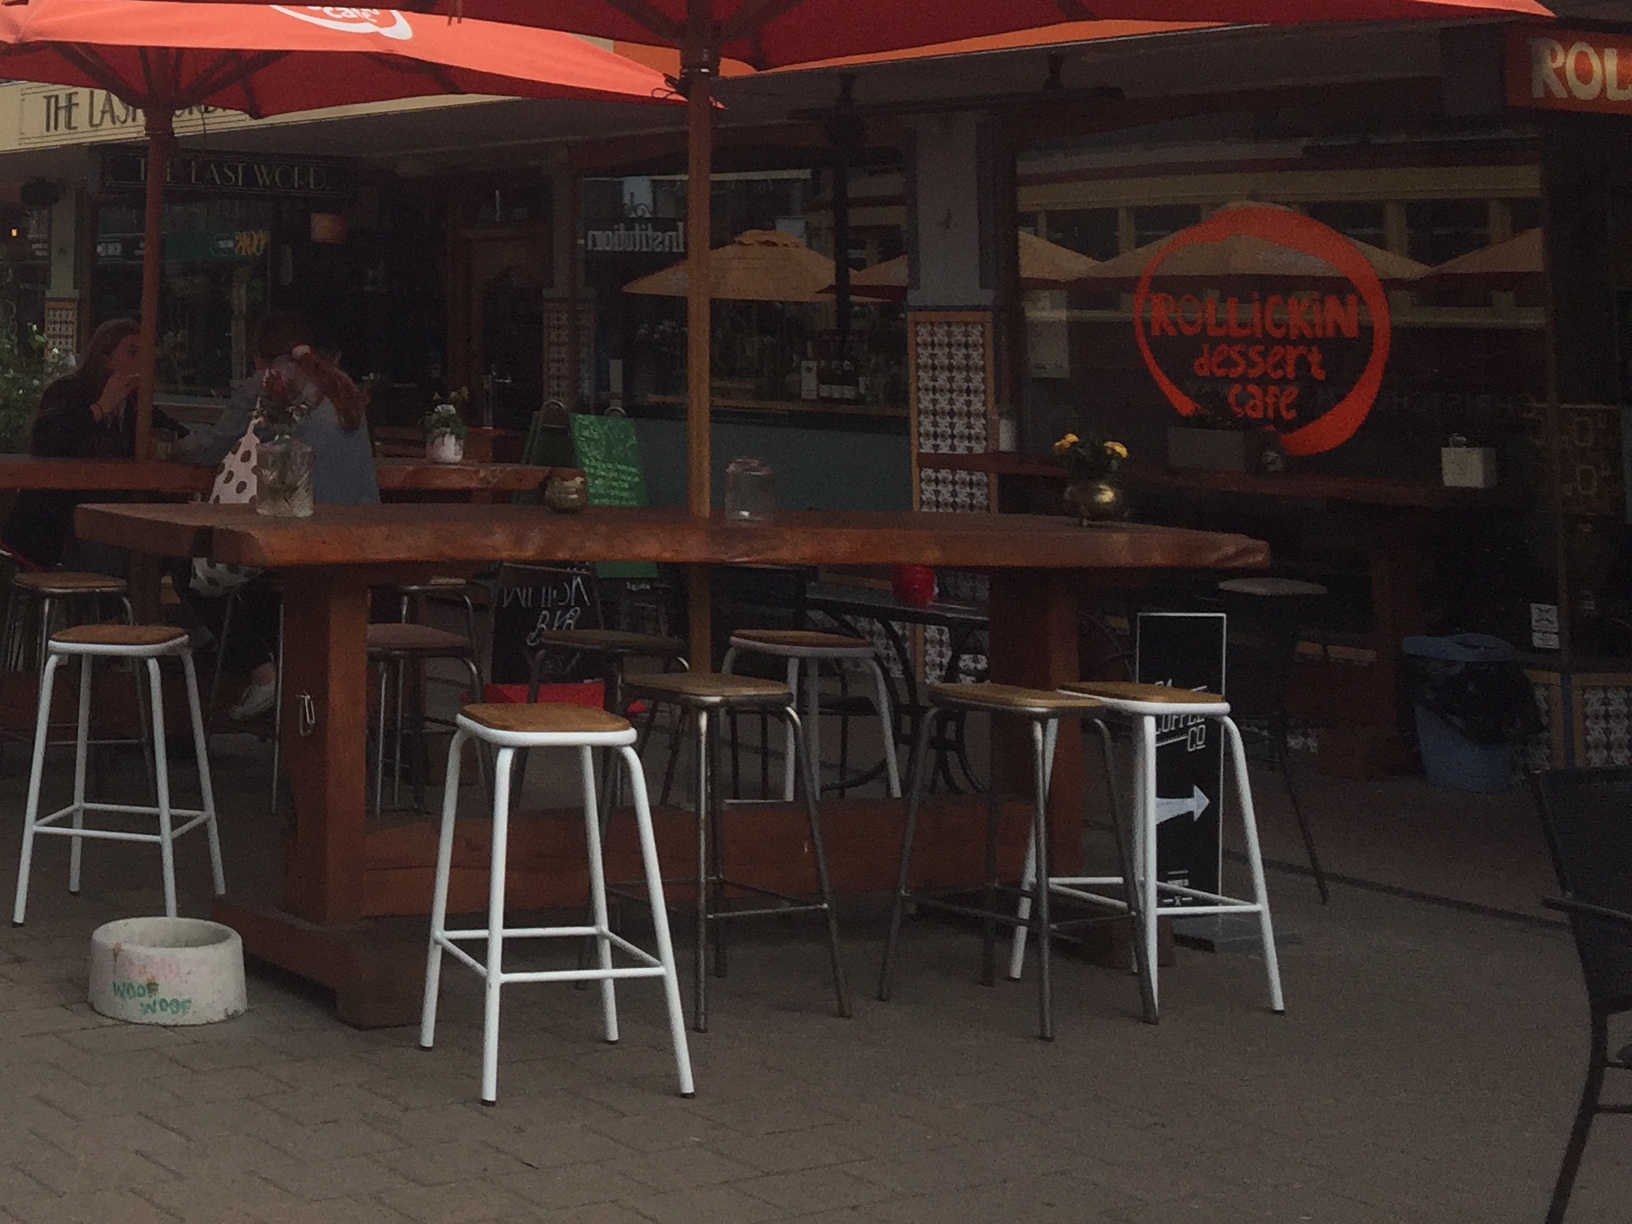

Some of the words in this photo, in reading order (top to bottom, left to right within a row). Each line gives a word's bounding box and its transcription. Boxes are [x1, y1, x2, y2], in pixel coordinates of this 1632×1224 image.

[43, 91, 79, 133] THE
[137, 158, 171, 182] TE
[190, 160, 246, 187] LAST
[1193, 343, 1326, 380] dessert
[1227, 383, 1300, 419] cafe
[112, 979, 159, 998] WOOF
[140, 997, 192, 1015] WOOF
